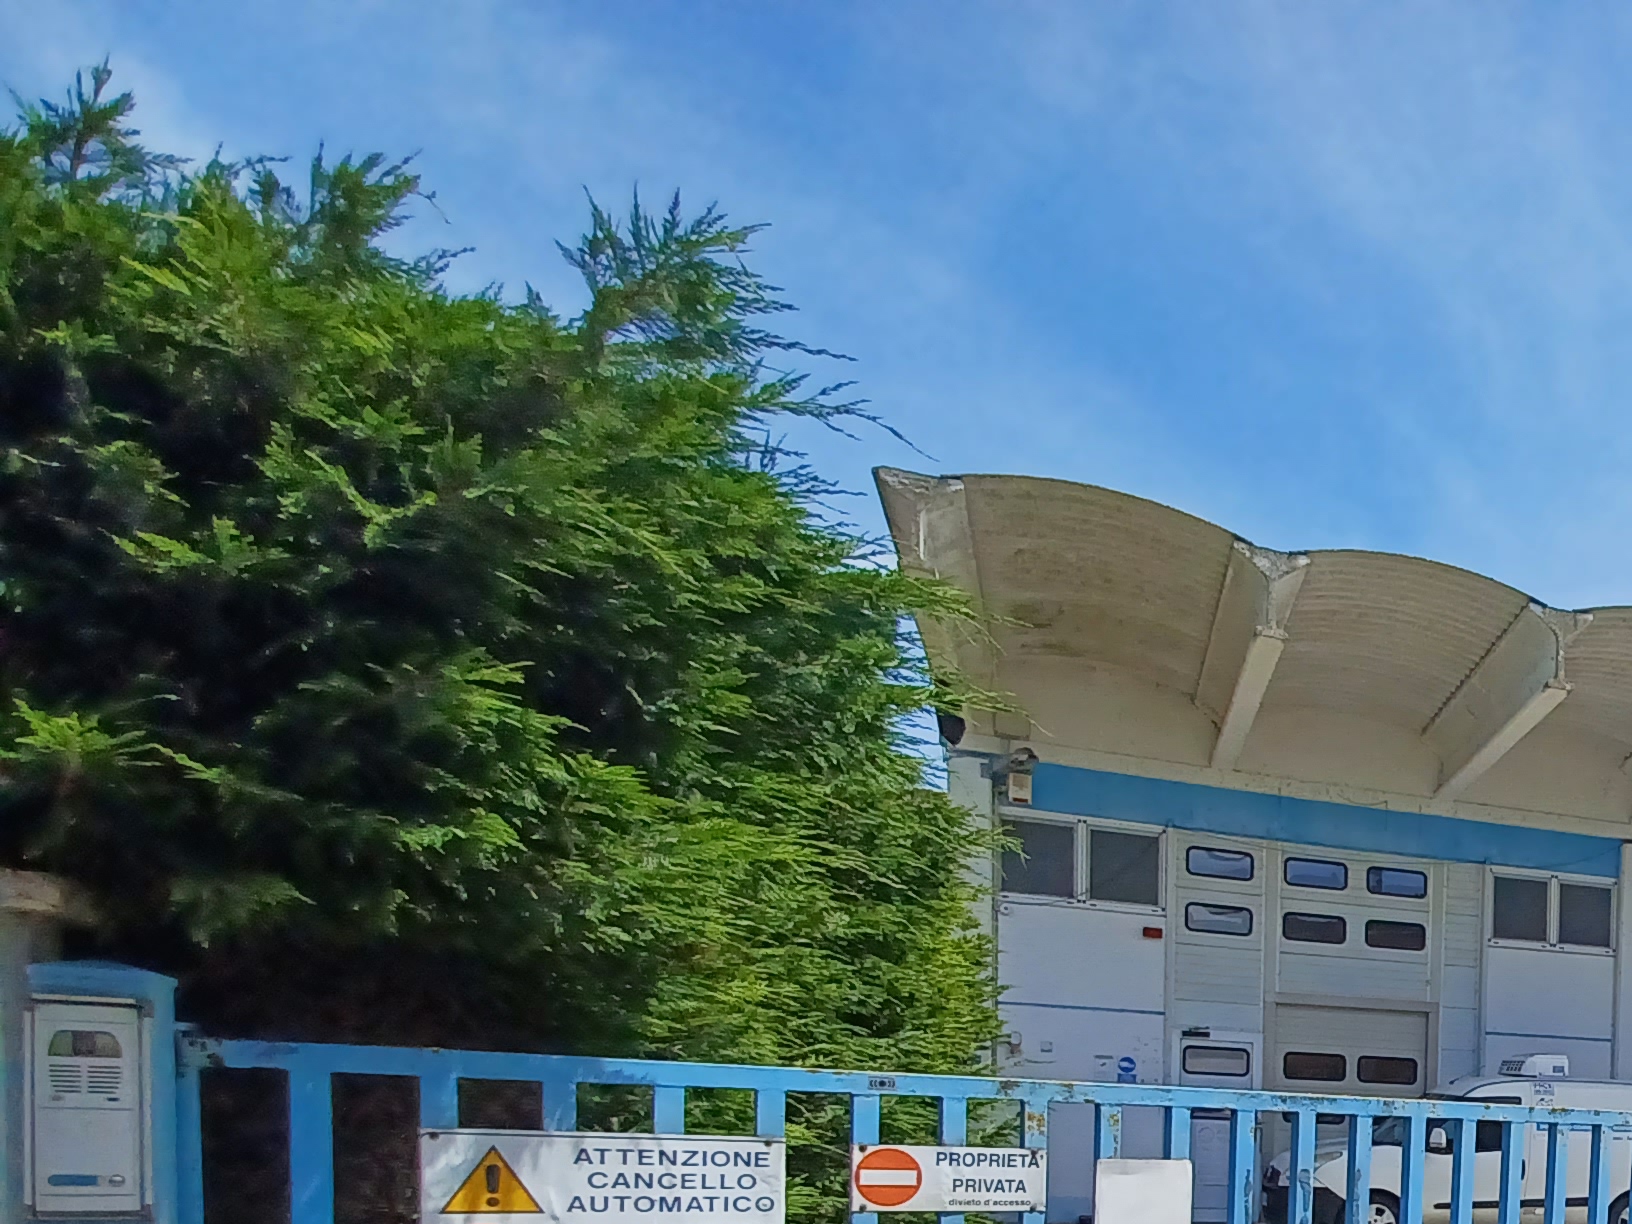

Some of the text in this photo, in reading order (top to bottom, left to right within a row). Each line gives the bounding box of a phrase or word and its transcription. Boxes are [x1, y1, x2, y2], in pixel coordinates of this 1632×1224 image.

[573, 1148, 771, 1167] ATTENZIONE
[587, 1172, 757, 1190] CANCELLO
[952, 1178, 1027, 1193] PRIVATA
[566, 1195, 775, 1213] AUTOMATICO
[948, 1198, 1031, 1206] divieto d'accesso
